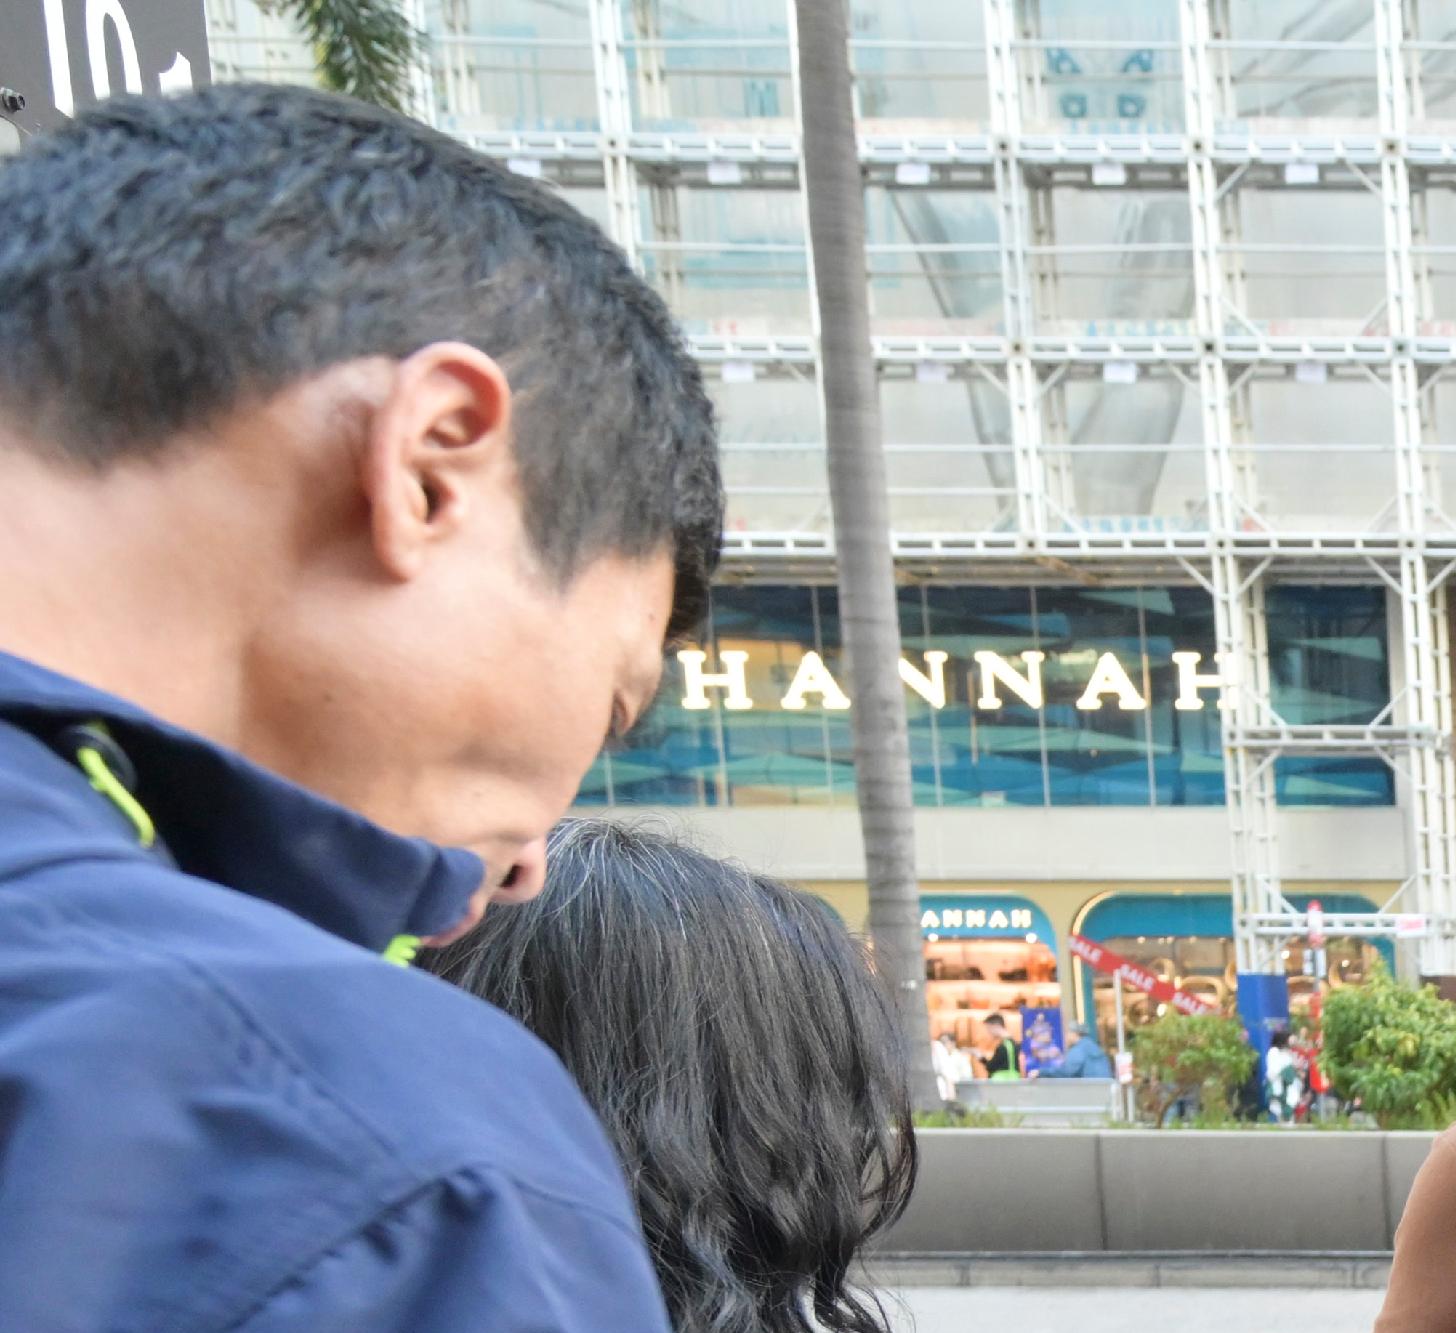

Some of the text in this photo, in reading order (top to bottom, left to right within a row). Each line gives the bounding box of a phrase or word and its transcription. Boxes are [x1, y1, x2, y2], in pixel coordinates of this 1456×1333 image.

[677, 650, 1238, 710] HANNAH
[920, 908, 1032, 928] ANNAH
[1119, 963, 1154, 991] SALE
